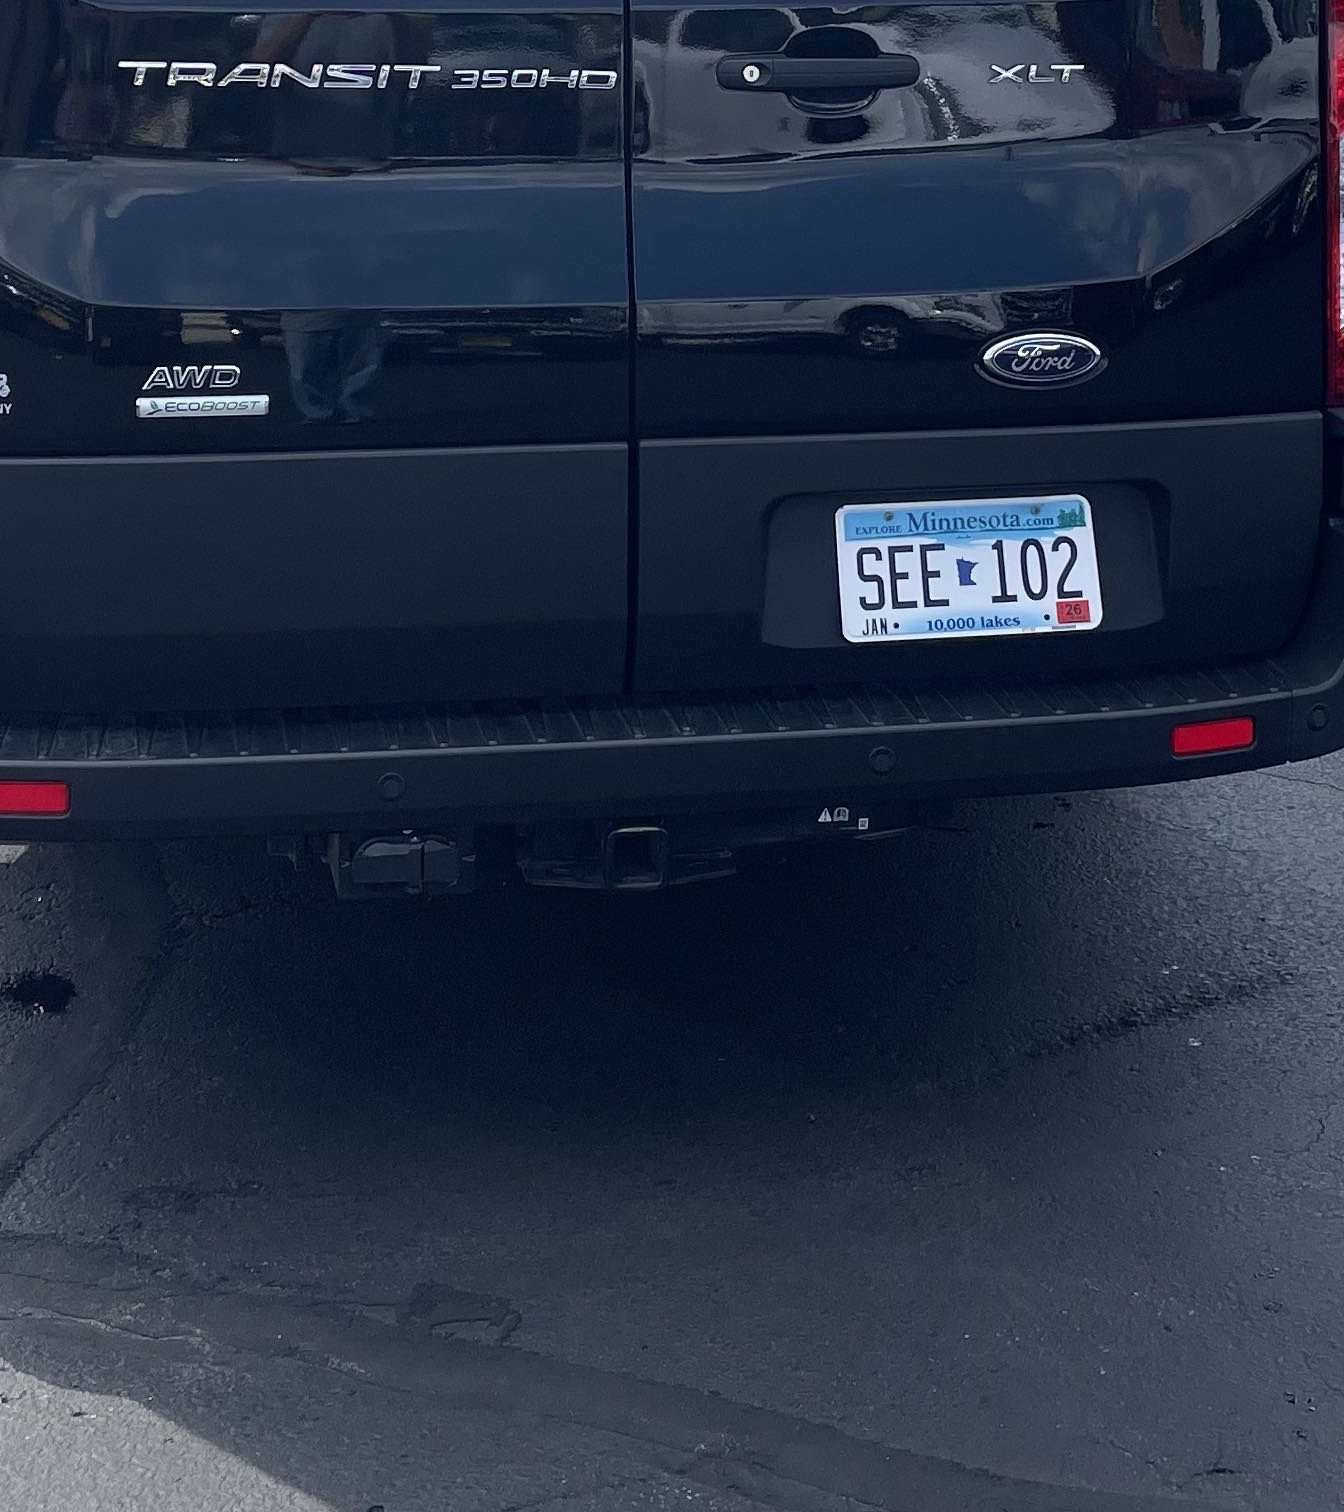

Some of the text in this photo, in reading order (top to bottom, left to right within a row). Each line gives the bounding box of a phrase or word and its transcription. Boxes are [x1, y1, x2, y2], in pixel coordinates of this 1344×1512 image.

[118, 60, 618, 90] TRANSIT 350HD
[988, 64, 1085, 83] XLT
[1011, 344, 1076, 372] Ford
[141, 364, 241, 391] AWD
[164, 399, 261, 413] ECOBOOST
[855, 524, 903, 536] EXPLORE
[856, 535, 1083, 611] SEE 102
[1064, 603, 1082, 616] 26
[862, 617, 888, 636] JAN
[927, 615, 1021, 632] 10,000 lakes
